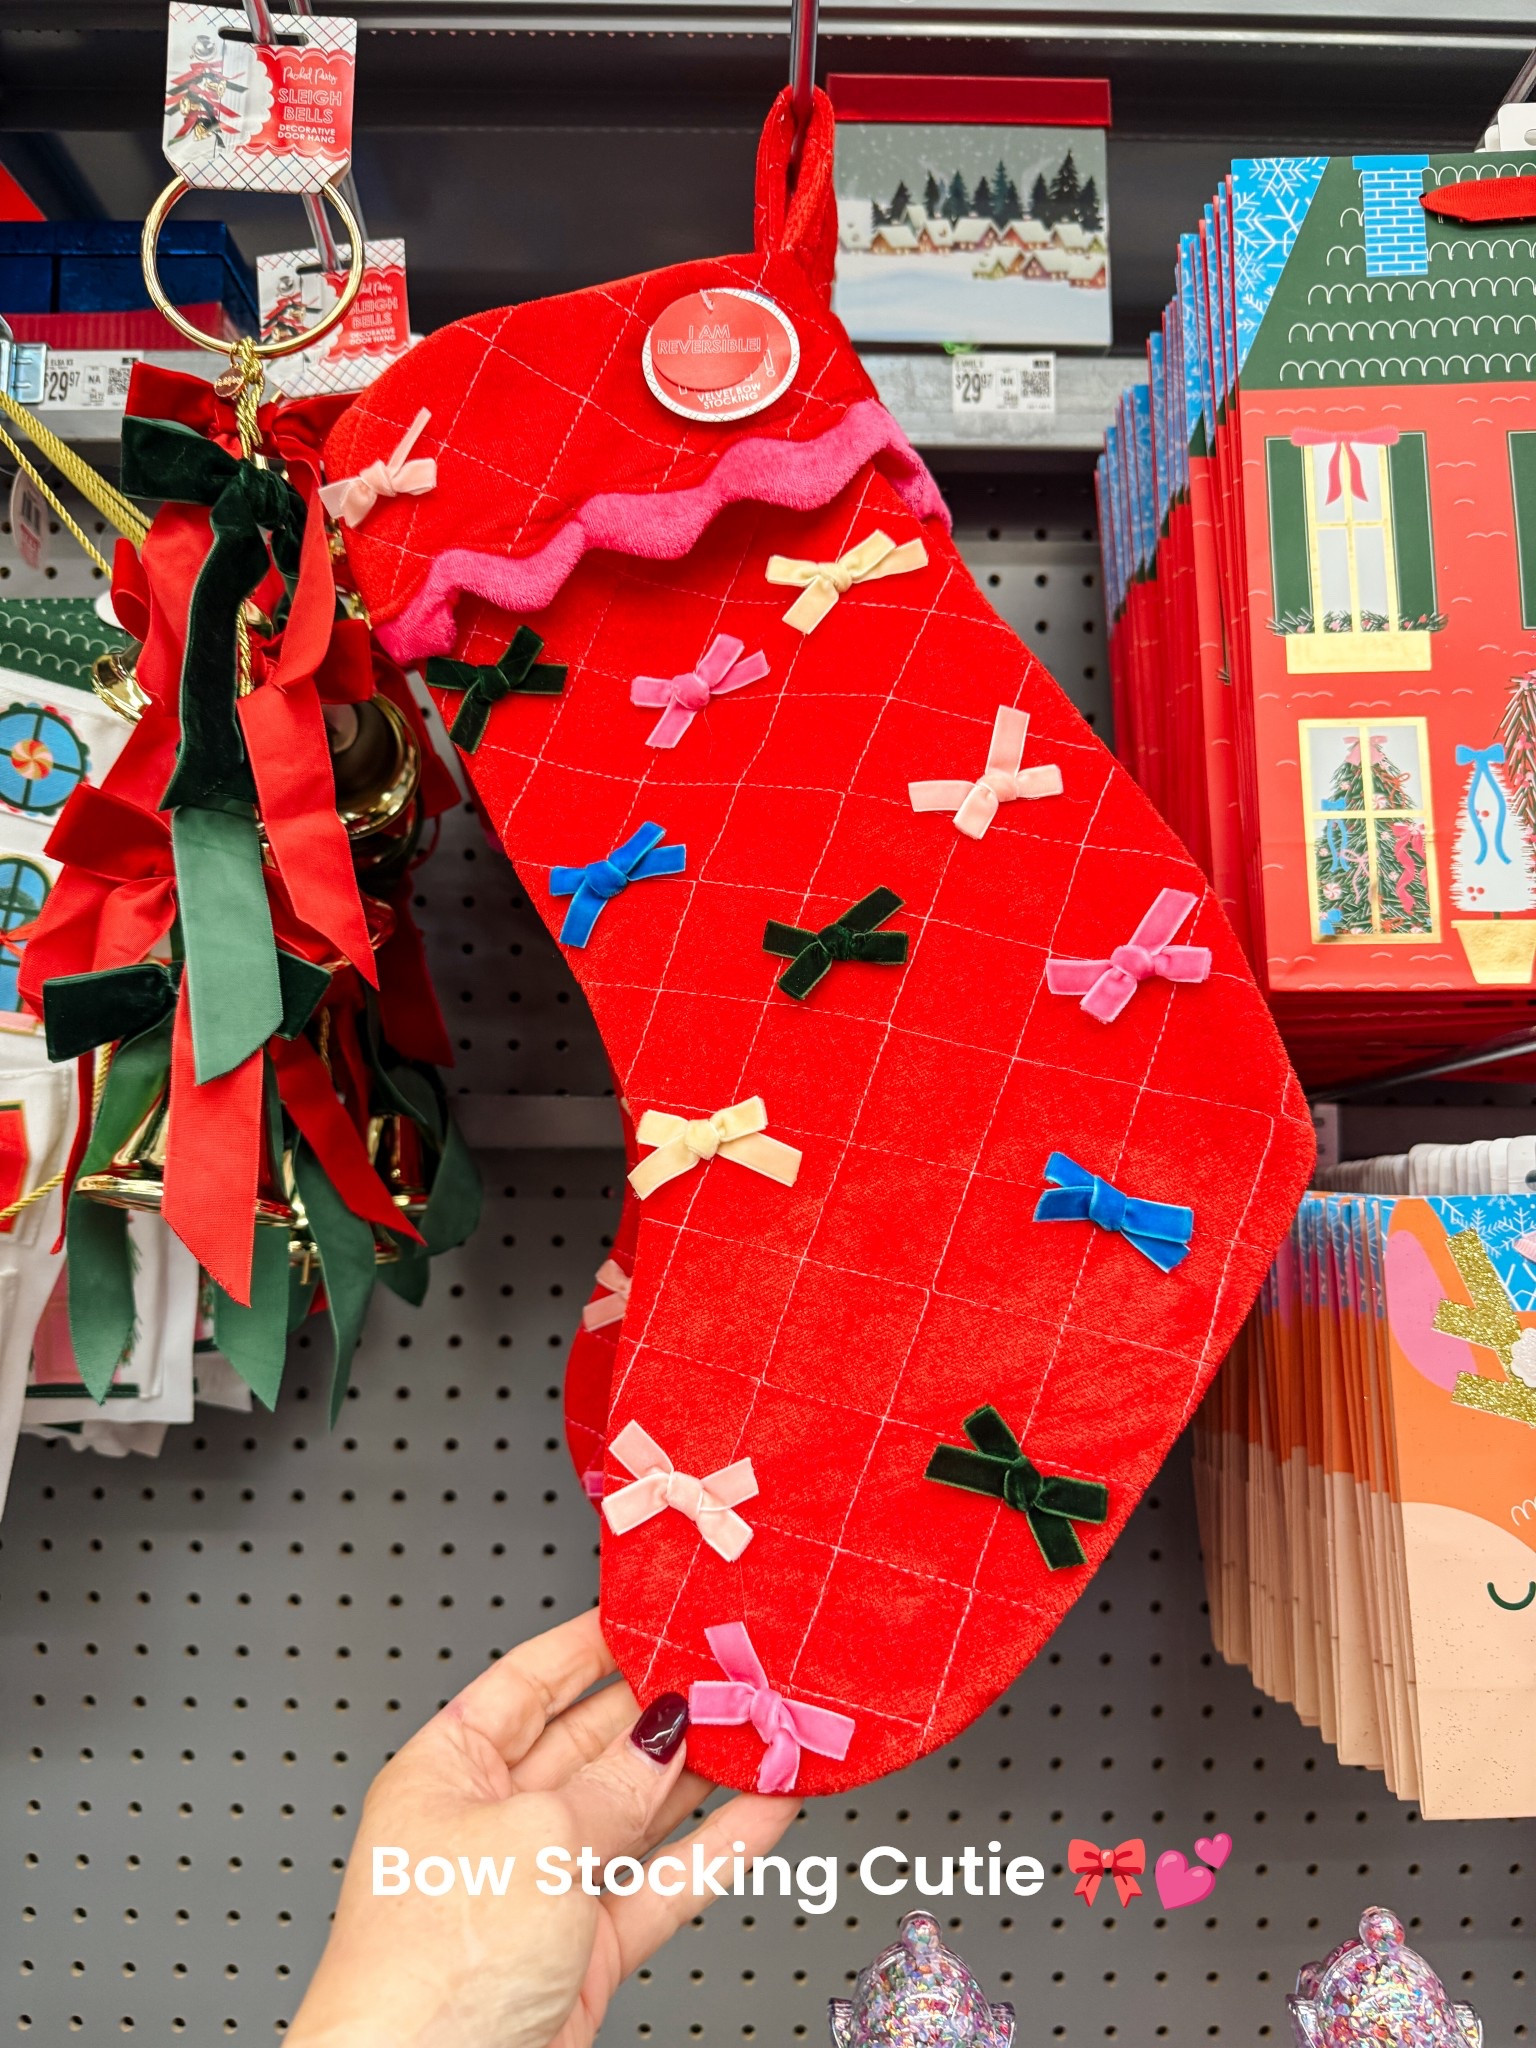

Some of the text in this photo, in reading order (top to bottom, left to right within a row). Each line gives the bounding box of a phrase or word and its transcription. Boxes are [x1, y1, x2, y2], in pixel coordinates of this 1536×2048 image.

[314, 67, 338, 85] Party
[277, 88, 343, 106] SLEIGH
[283, 106, 334, 124] BELLS
[277, 131, 336, 144] DOOR HANG
[279, 124, 335, 135] DECORATIVE
[352, 312, 393, 329] BELLS
[688, 325, 730, 338] I AM
[657, 337, 761, 355] REVERSIBLE!
[697, 389, 734, 402] VELVET
[736, 384, 761, 395] BOW
[703, 391, 759, 409] STOCKING
